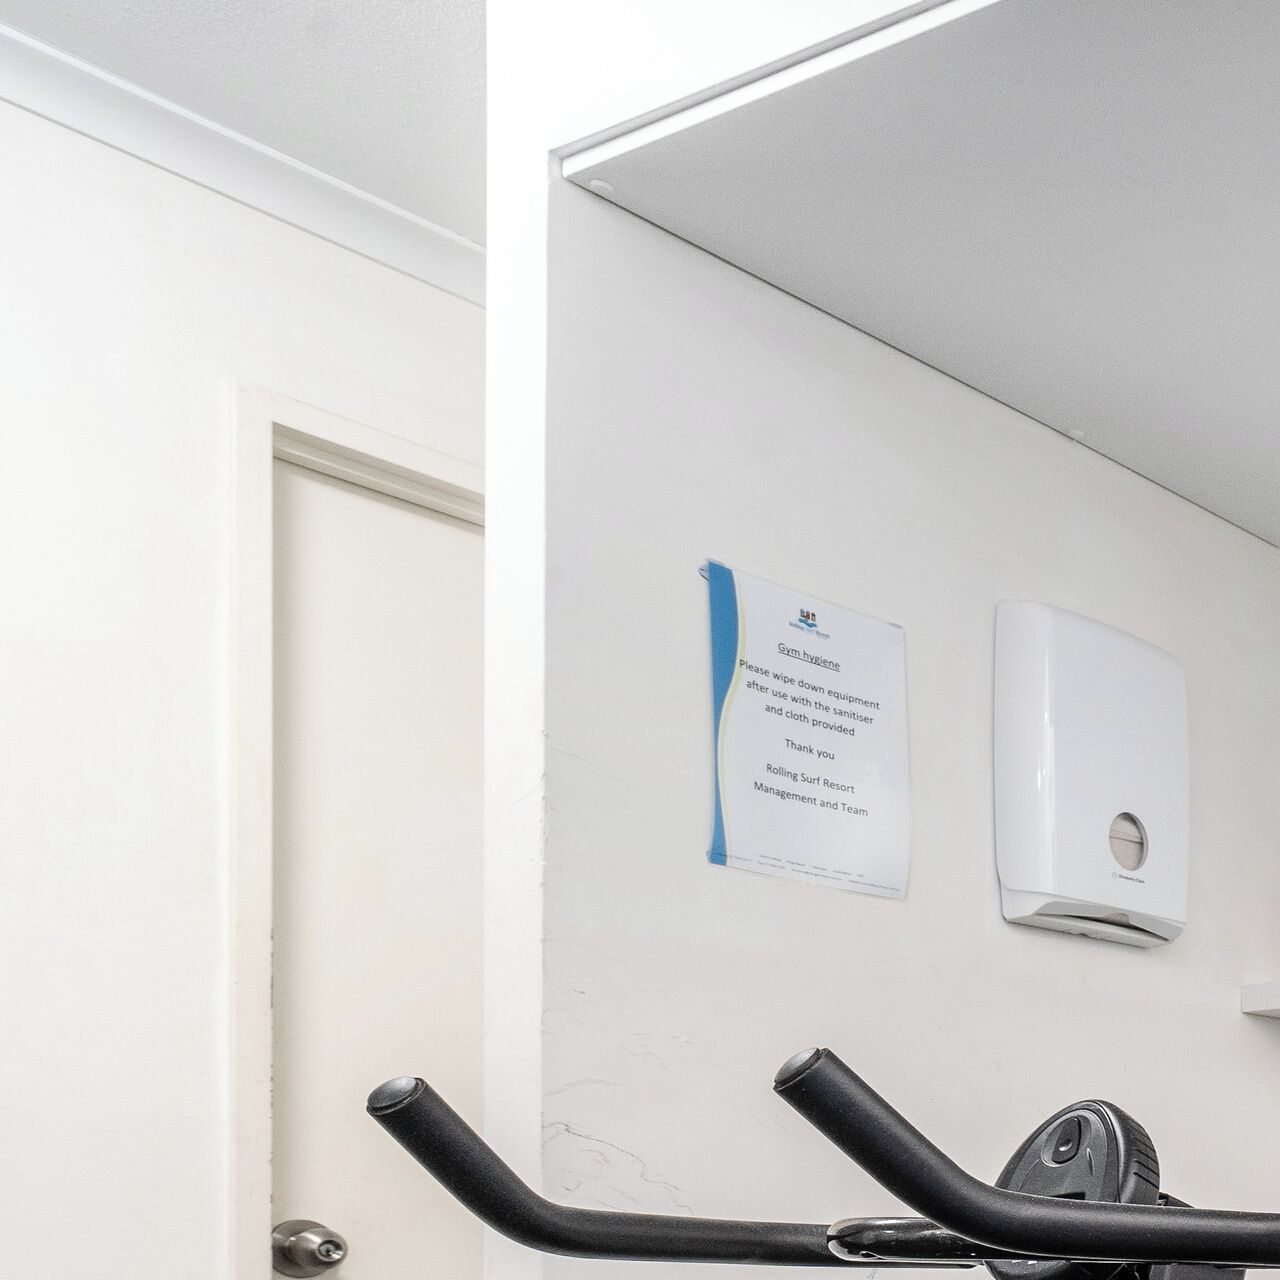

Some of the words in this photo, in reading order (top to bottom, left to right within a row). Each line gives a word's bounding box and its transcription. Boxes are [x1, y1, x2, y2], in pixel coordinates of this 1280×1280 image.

[778, 643, 801, 658] Gym
[803, 650, 841, 671] hygiene
[739, 659, 770, 677] Please
[772, 671, 796, 686] wipe
[798, 679, 825, 694] down
[827, 689, 881, 711] equipment
[746, 680, 769, 694] after
[772, 689, 788, 701] use
[791, 693, 812, 708] with
[814, 701, 831, 713] the
[833, 707, 874, 725] sanitiser
[765, 704, 783, 716] and
[785, 710, 809, 724] cloth
[812, 718, 855, 736] provided
[785, 738, 814, 755] Thank
[816, 749, 835, 760] you
[766, 763, 798, 783] Rolling
[800, 772, 821, 786] Surf
[823, 778, 855, 794] Resort
[754, 781, 817, 806] Management
[819, 801, 838, 811] and
[840, 803, 869, 817] Team
